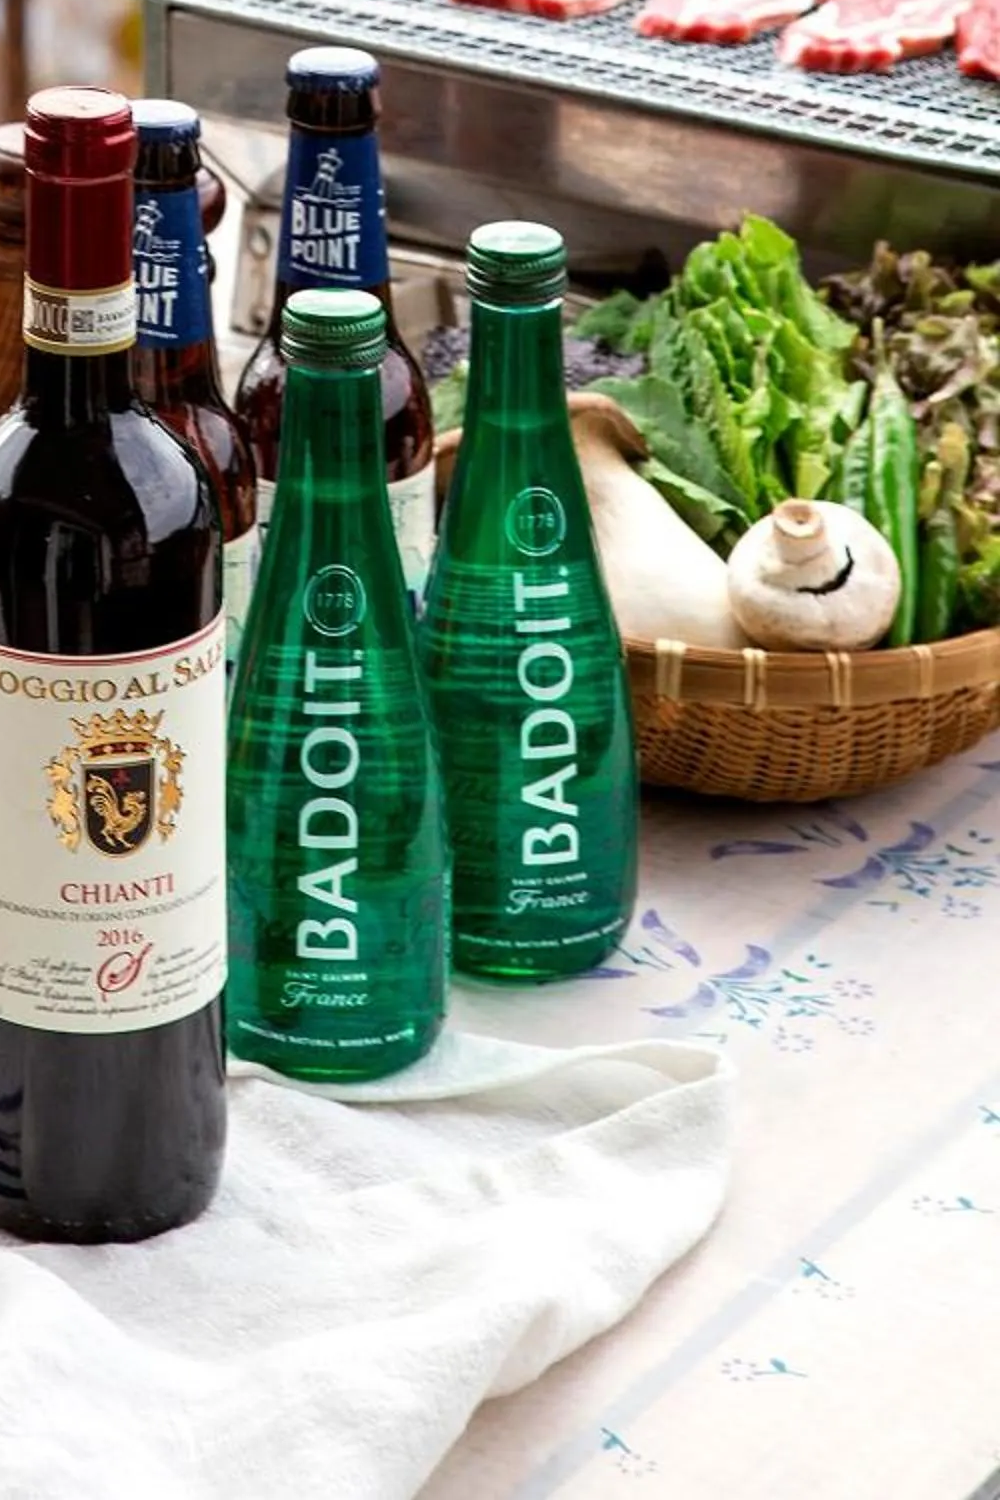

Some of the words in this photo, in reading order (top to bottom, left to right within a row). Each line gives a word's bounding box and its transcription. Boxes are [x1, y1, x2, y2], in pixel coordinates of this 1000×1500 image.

[292, 200, 361, 235] BLUE
[291, 234, 361, 270] POINT
[122, 672, 169, 700] AL
[59, 873, 175, 905] CHIANTI
[505, 888, 589, 914] France
[97, 929, 144, 947] 2016
[280, 981, 370, 1007] France
